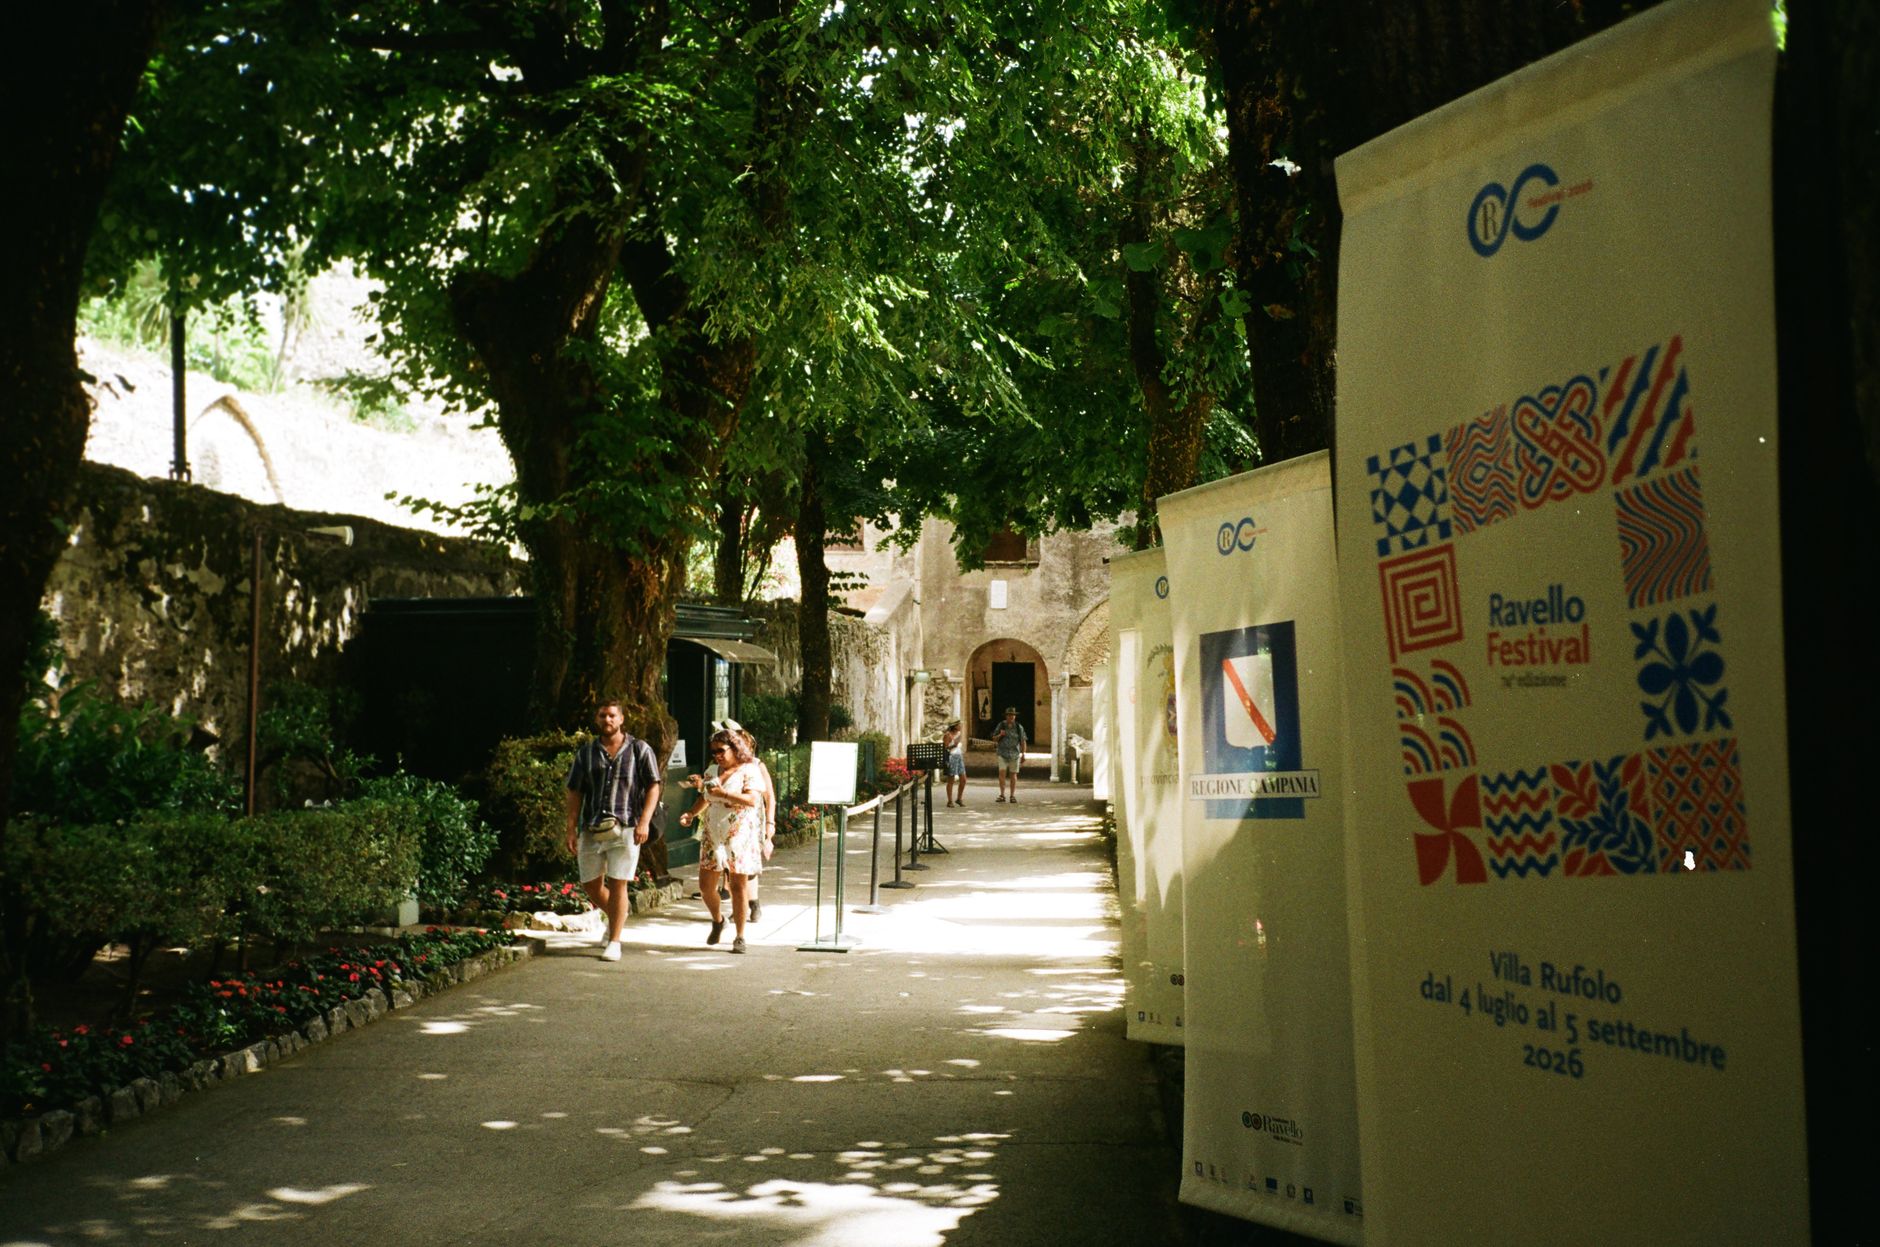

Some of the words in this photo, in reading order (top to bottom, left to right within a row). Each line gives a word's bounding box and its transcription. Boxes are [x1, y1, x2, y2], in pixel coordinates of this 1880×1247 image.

[1489, 583, 1585, 627] Ravello
[1487, 623, 1590, 667] Festival
[1191, 778, 1245, 796] REGIONE
[1249, 775, 1317, 794] CAMPANIA
[1490, 950, 1531, 987] Villa
[1540, 961, 1622, 1004] Rufolo
[1420, 972, 1452, 1003] dal
[1459, 988, 1472, 1016] 4
[1478, 983, 1528, 1027] luglio
[1537, 1001, 1556, 1031] al
[1566, 1013, 1578, 1045] 5
[1587, 1016, 1727, 1071] settembre
[1523, 1044, 1584, 1079] 2026
[1263, 1115, 1303, 1139] Ravello
